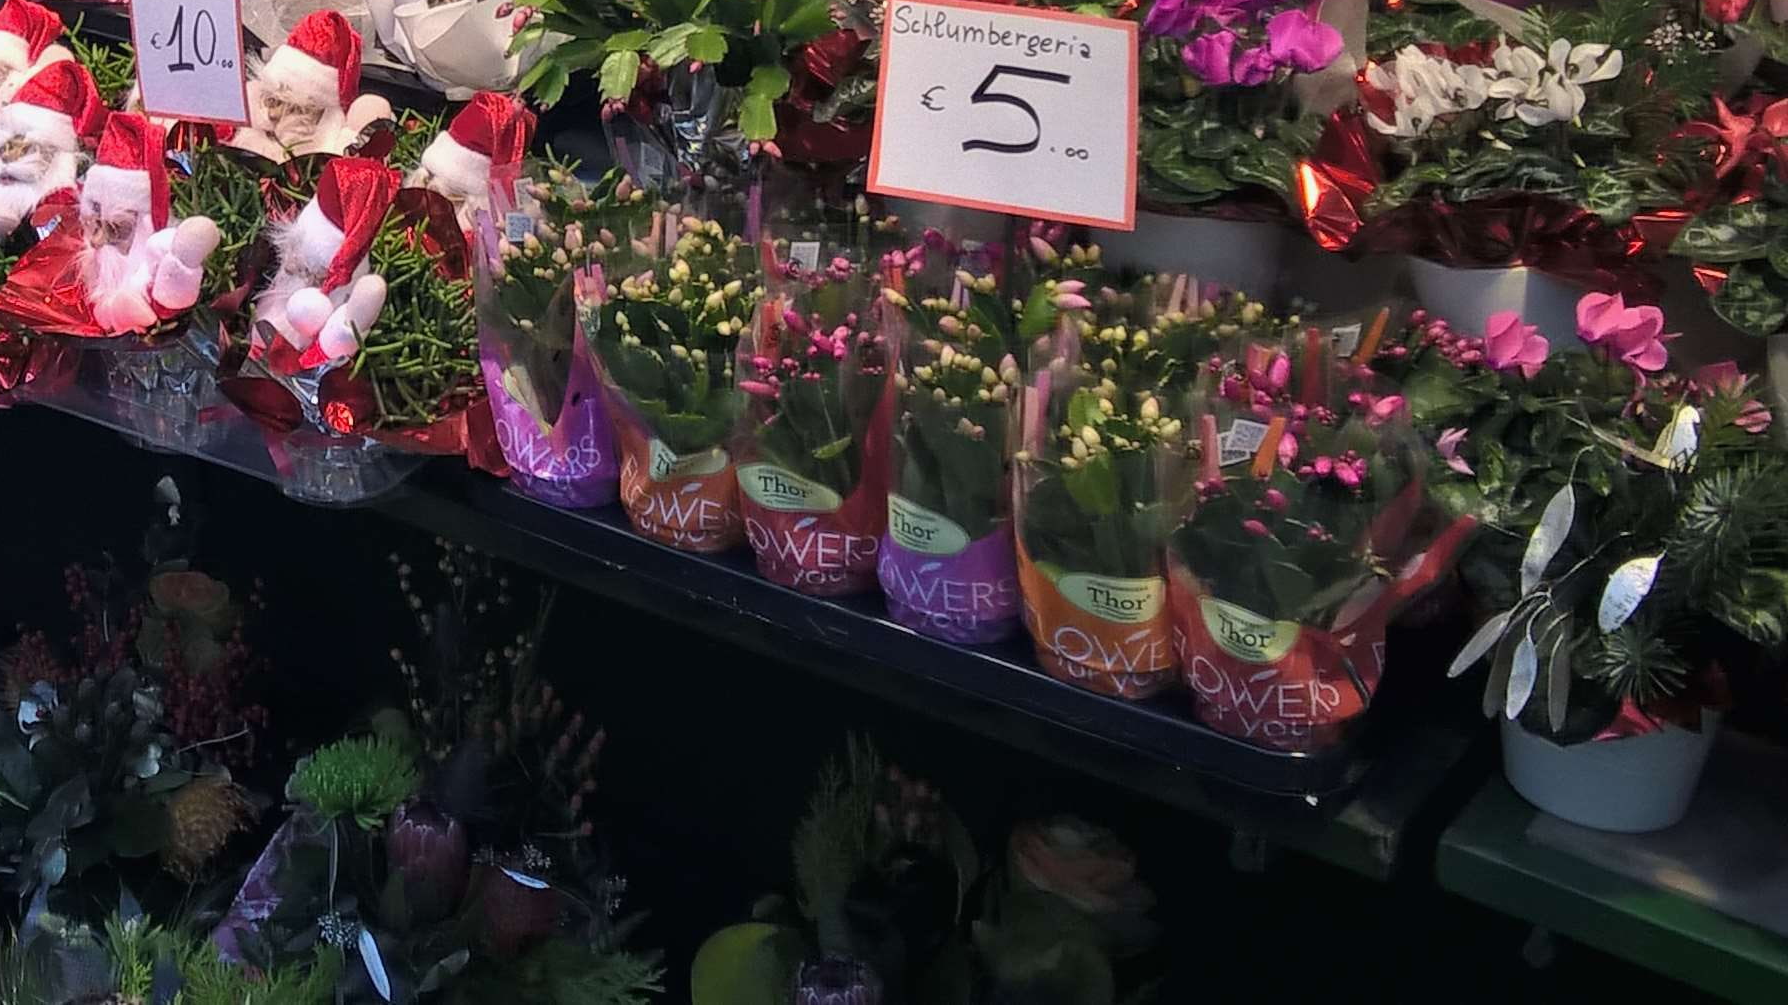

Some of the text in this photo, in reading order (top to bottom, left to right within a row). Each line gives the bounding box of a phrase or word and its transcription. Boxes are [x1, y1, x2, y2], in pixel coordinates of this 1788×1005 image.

[892, 5, 1092, 59] Schlumbergeria
[759, 475, 813, 498] Thor
[892, 508, 935, 541] Thor
[1088, 586, 1147, 611] Thor
[1218, 613, 1269, 648] Thor
